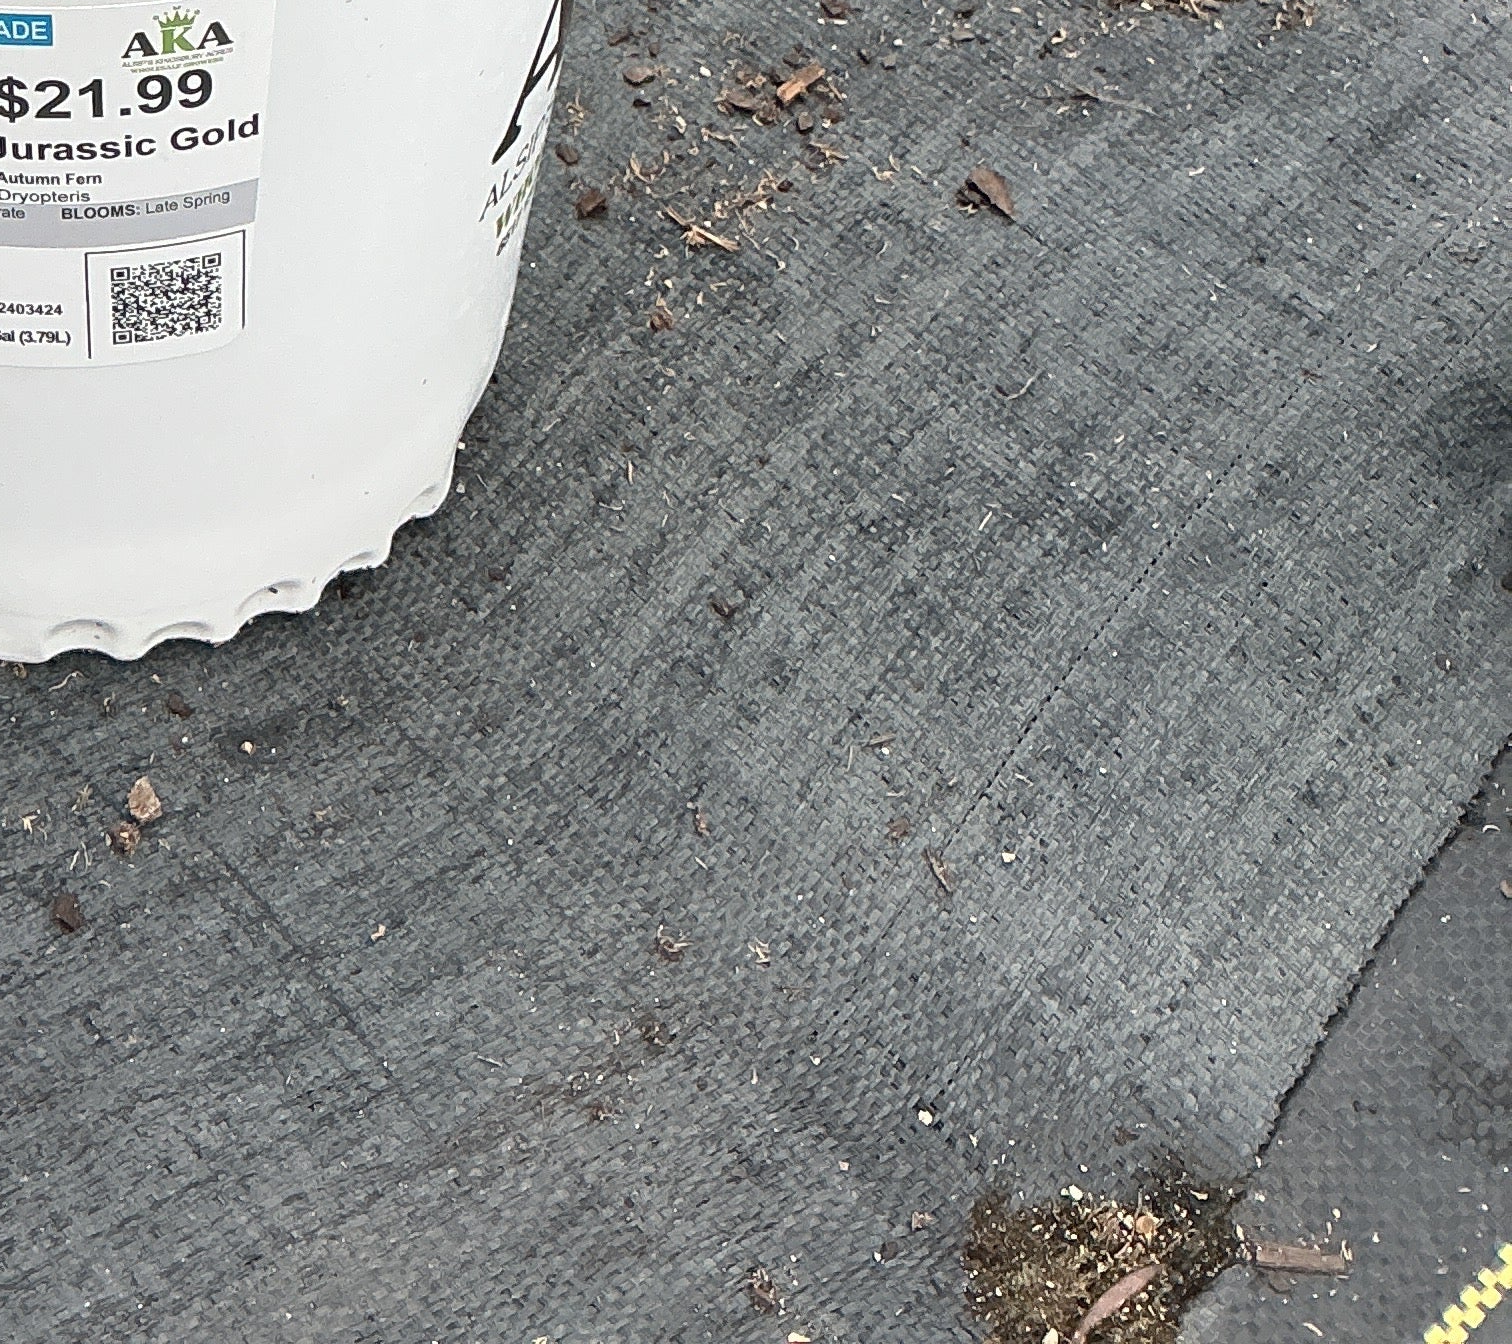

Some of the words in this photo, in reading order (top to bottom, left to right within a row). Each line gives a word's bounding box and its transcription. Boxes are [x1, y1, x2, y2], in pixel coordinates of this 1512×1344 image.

[121, 20, 234, 58] AKA
[170, 113, 260, 151] Gold
[65, 172, 103, 186] Fern
[60, 204, 141, 221] BLOOMS:
[145, 199, 179, 215] Late
[182, 190, 231, 210] Spring
[19, 330, 72, 347] (3.79L)
